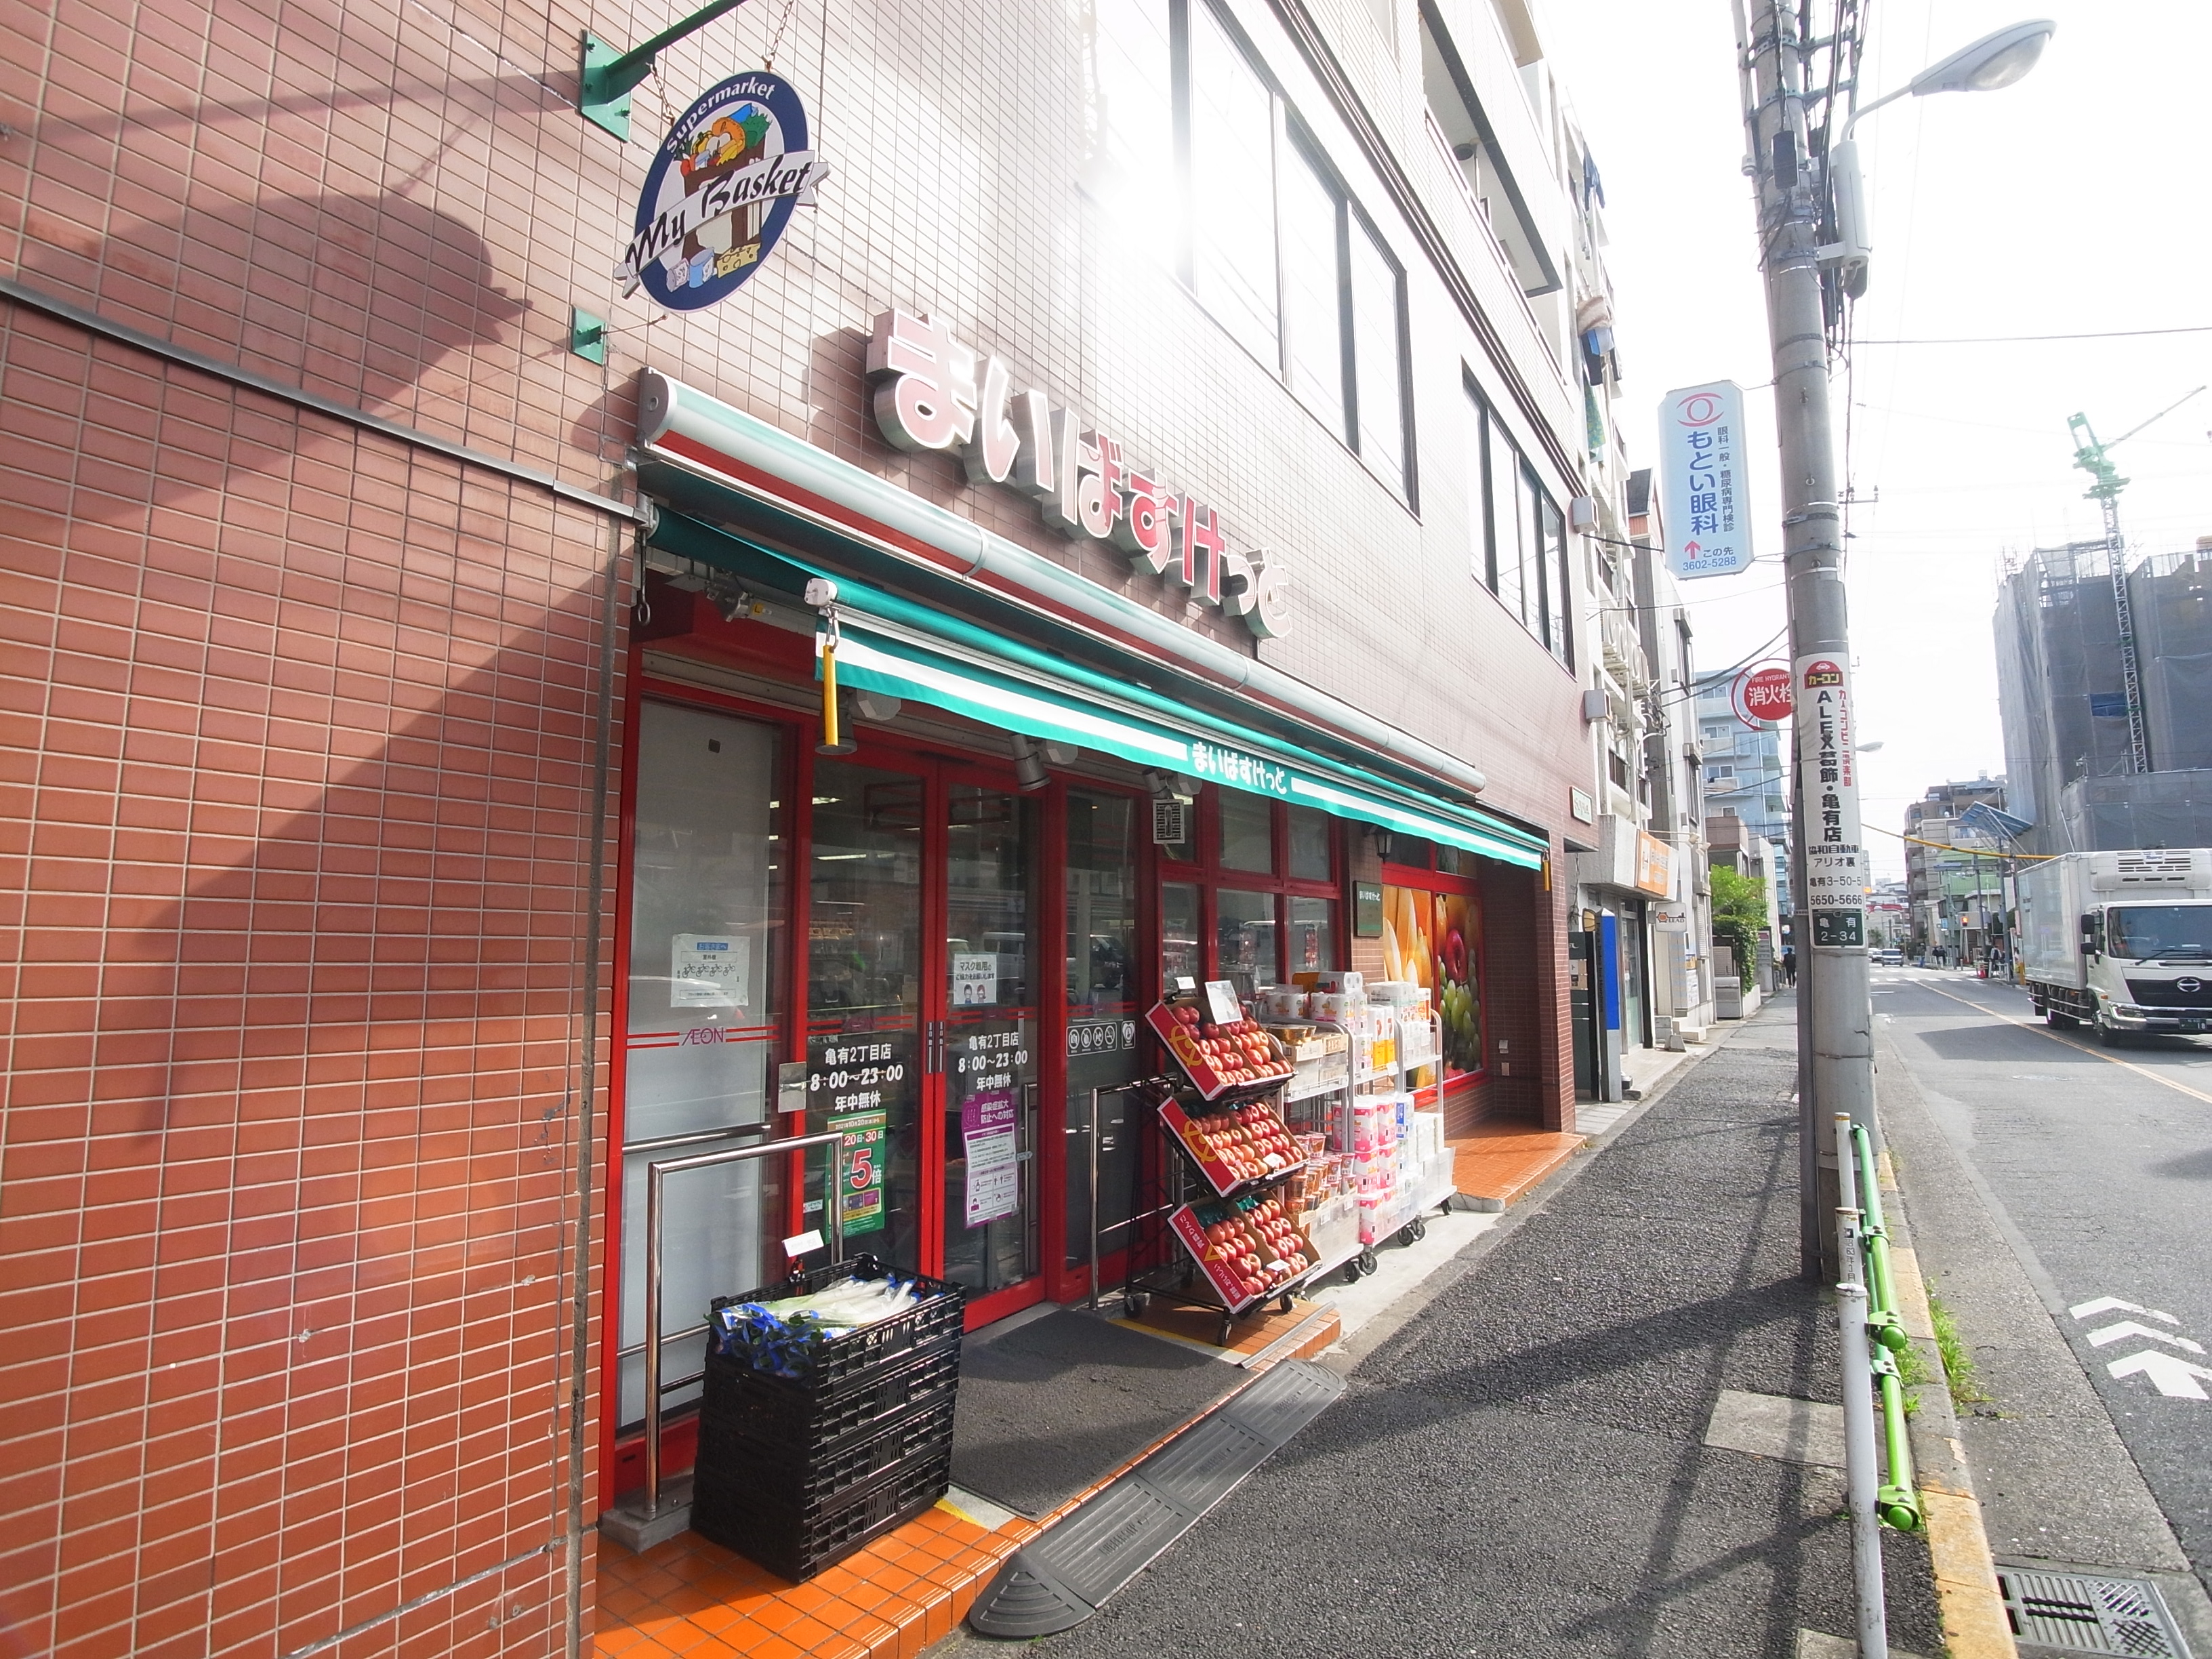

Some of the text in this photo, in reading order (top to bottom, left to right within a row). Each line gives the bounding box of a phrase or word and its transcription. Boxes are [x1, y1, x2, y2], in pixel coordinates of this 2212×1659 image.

[667, 77, 775, 152] Supermarket
[625, 154, 812, 274] My Basket
[883, 308, 1291, 638] まいばすけっと
[1687, 431, 1719, 535] もとい眼科
[1703, 546, 1734, 558] この先
[1683, 556, 1736, 571] 3602-5288
[1808, 672, 1839, 686] カーコン
[1192, 741, 1288, 795] まいばすけっと
[1808, 844, 1860, 855] 協和自動車
[1814, 857, 1856, 867] アリオ裏
[1810, 894, 1862, 905] 5650-5666
[1821, 931, 1856, 941] 2-34
[960, 961, 992, 971] マスク着用の
[968, 1031, 1019, 1050] 亀有2丁目店
[825, 1042, 892, 1065] 亀有2丁目店
[976, 1071, 1012, 1091] 年中無休
[834, 1089, 882, 1113] 年中無休
[981, 1099, 1009, 1113] 感染症拡大
[981, 1109, 1015, 1124] 防止への対応
